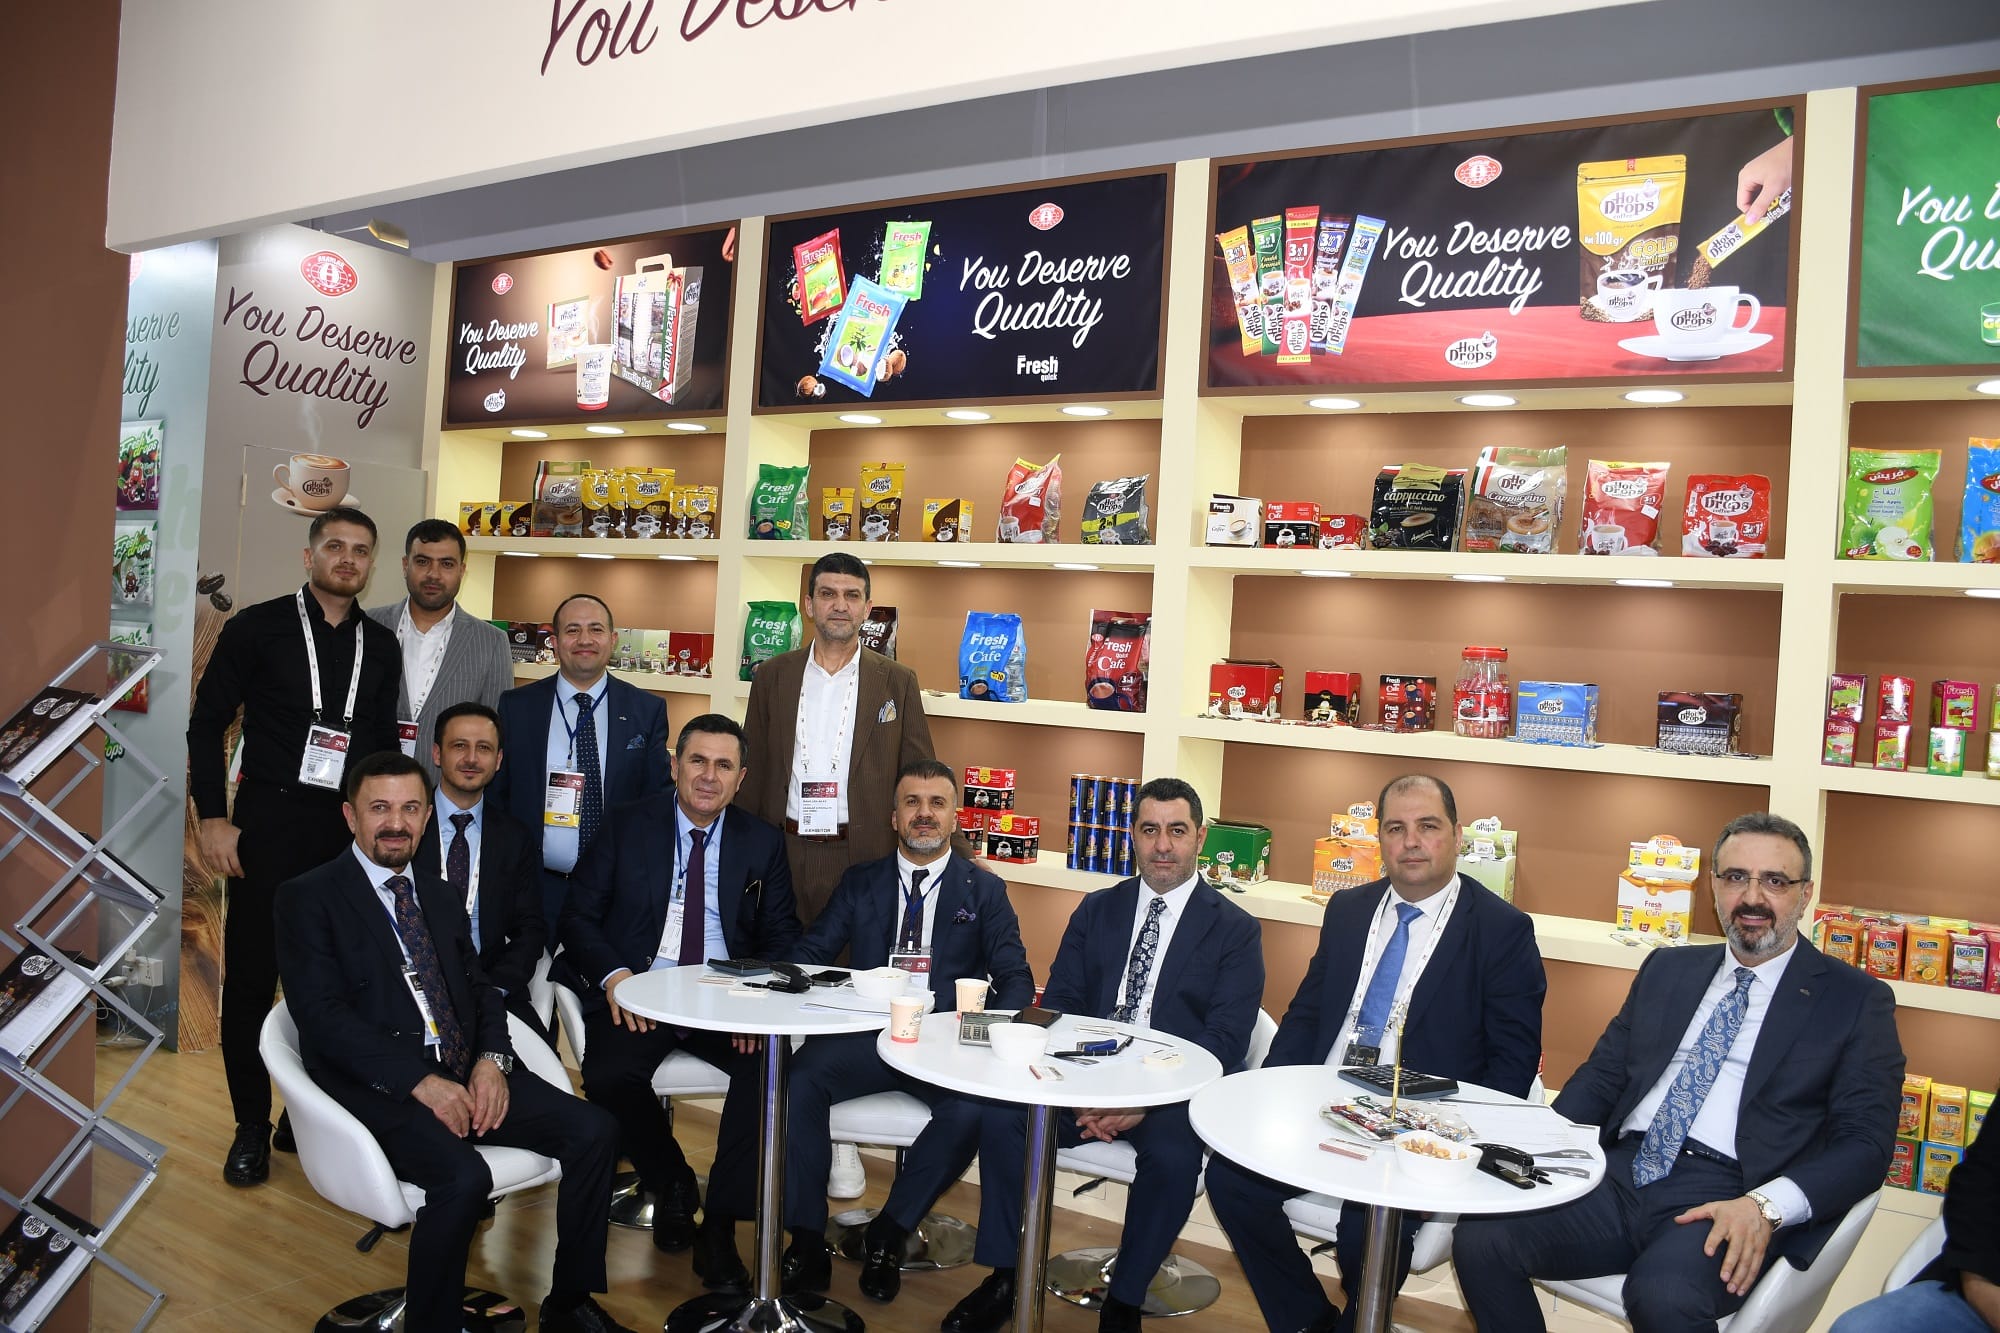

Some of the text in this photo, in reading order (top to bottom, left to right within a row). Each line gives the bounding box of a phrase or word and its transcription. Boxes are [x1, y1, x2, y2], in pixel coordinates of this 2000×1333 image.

[1612, 192, 1639, 204] Hot
[1604, 201, 1654, 215] Drops
[1897, 185, 1973, 225] You
[893, 231, 922, 241] Fresh
[1383, 221, 1572, 262] You Deserve
[1595, 231, 1612, 245] 100
[1713, 234, 1730, 249] Hot
[1629, 235, 1679, 258] GOLD
[1710, 232, 1743, 258] Drops
[801, 243, 834, 266] Fresh
[960, 251, 1131, 291] You Deserve
[1399, 256, 1543, 316] Quality
[854, 291, 891, 318] Fresh
[1609, 299, 1633, 307] Drops
[971, 288, 1104, 350] Quality
[1312, 305, 1328, 338] Drops
[1676, 315, 1713, 326] Drops
[1684, 311, 1702, 319] Hot
[127, 311, 181, 343] serve
[223, 286, 416, 364] You Deserve
[1330, 311, 1349, 342] Drops
[460, 322, 486, 345] You
[487, 319, 539, 342] Deserve
[1293, 323, 1304, 351] Drops
[1456, 341, 1479, 352] Hot
[465, 342, 526, 380] Quality
[1450, 349, 1492, 363] Drops
[1017, 356, 1059, 375] Fresh
[122, 349, 160, 418] lity
[240, 340, 388, 429] Quality
[1508, 474, 1525, 484] Ho
[1615, 481, 1632, 489] Hot
[760, 482, 794, 493] Fresh
[870, 483, 889, 491] Drops
[1605, 485, 1643, 495] Drops
[757, 494, 789, 505] Cafe
[1383, 491, 1445, 503] cappuccino
[1712, 492, 1736, 502] Hot
[1100, 503, 1122, 512] Drops
[1268, 503, 1283, 511] Fresh
[1705, 497, 1749, 512] Drops
[752, 618, 787, 631] Fresh
[858, 622, 886, 633] resh
[751, 633, 784, 646] Cafe
[970, 633, 1009, 646] Fresh
[1101, 639, 1132, 653] Fresh
[969, 650, 1001, 664] Cafe
[1097, 657, 1126, 671] Cafe
[1946, 685, 1976, 696] Fresh
[1539, 704, 1561, 712] Drops
[1681, 713, 1704, 722] Drops
[1828, 722, 1855, 734] Fresh
[1350, 809, 1372, 817] Drops
[1475, 825, 1496, 833] Drops
[1655, 838, 1674, 847] Fresh
[1332, 862, 1352, 871] Drops
[1644, 900, 1662, 908] Fresh
